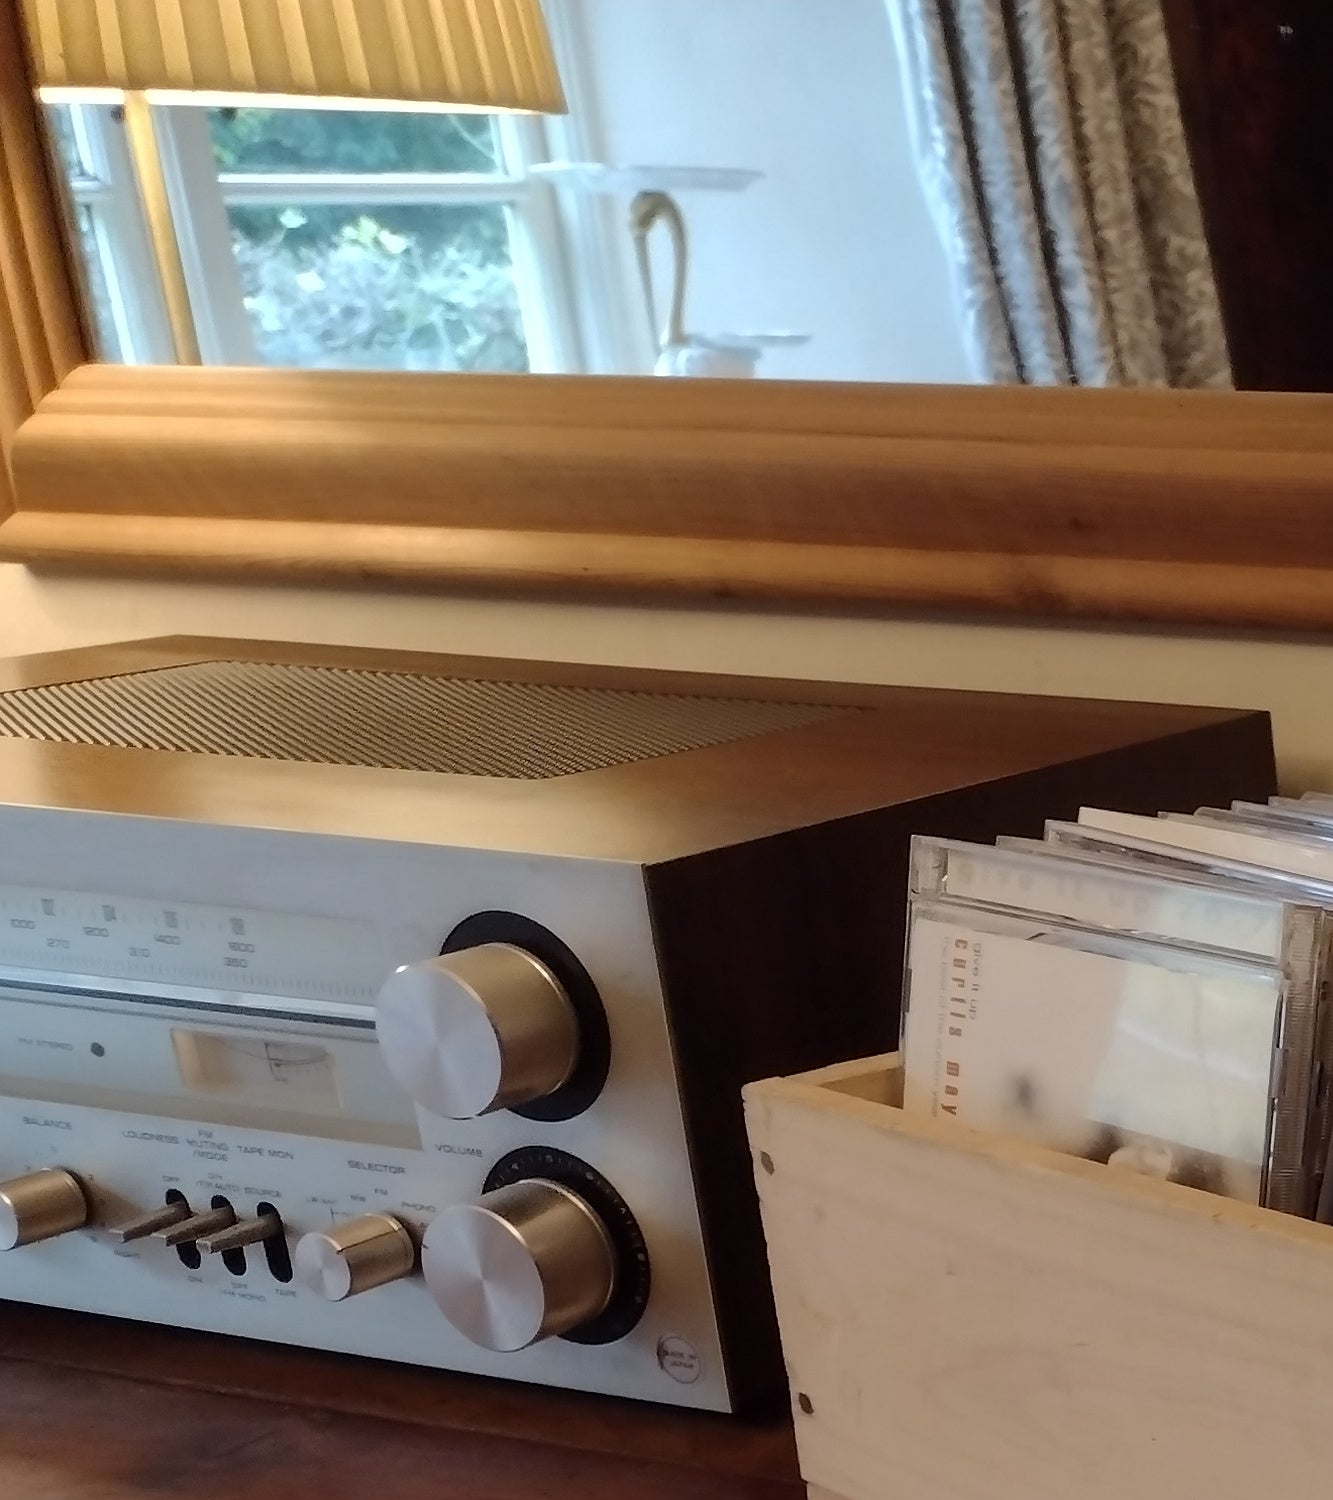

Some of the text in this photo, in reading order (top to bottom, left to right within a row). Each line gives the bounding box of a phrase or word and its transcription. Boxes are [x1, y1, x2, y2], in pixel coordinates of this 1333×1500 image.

[948, 937, 969, 1038] curtis
[22, 1116, 73, 1131] BALANCE
[122, 1130, 180, 1145] LOUDNESS
[237, 1145, 294, 1160] TAPE MON
[434, 1143, 484, 1158] VOLUME
[346, 1159, 407, 1175] SELECTOR
